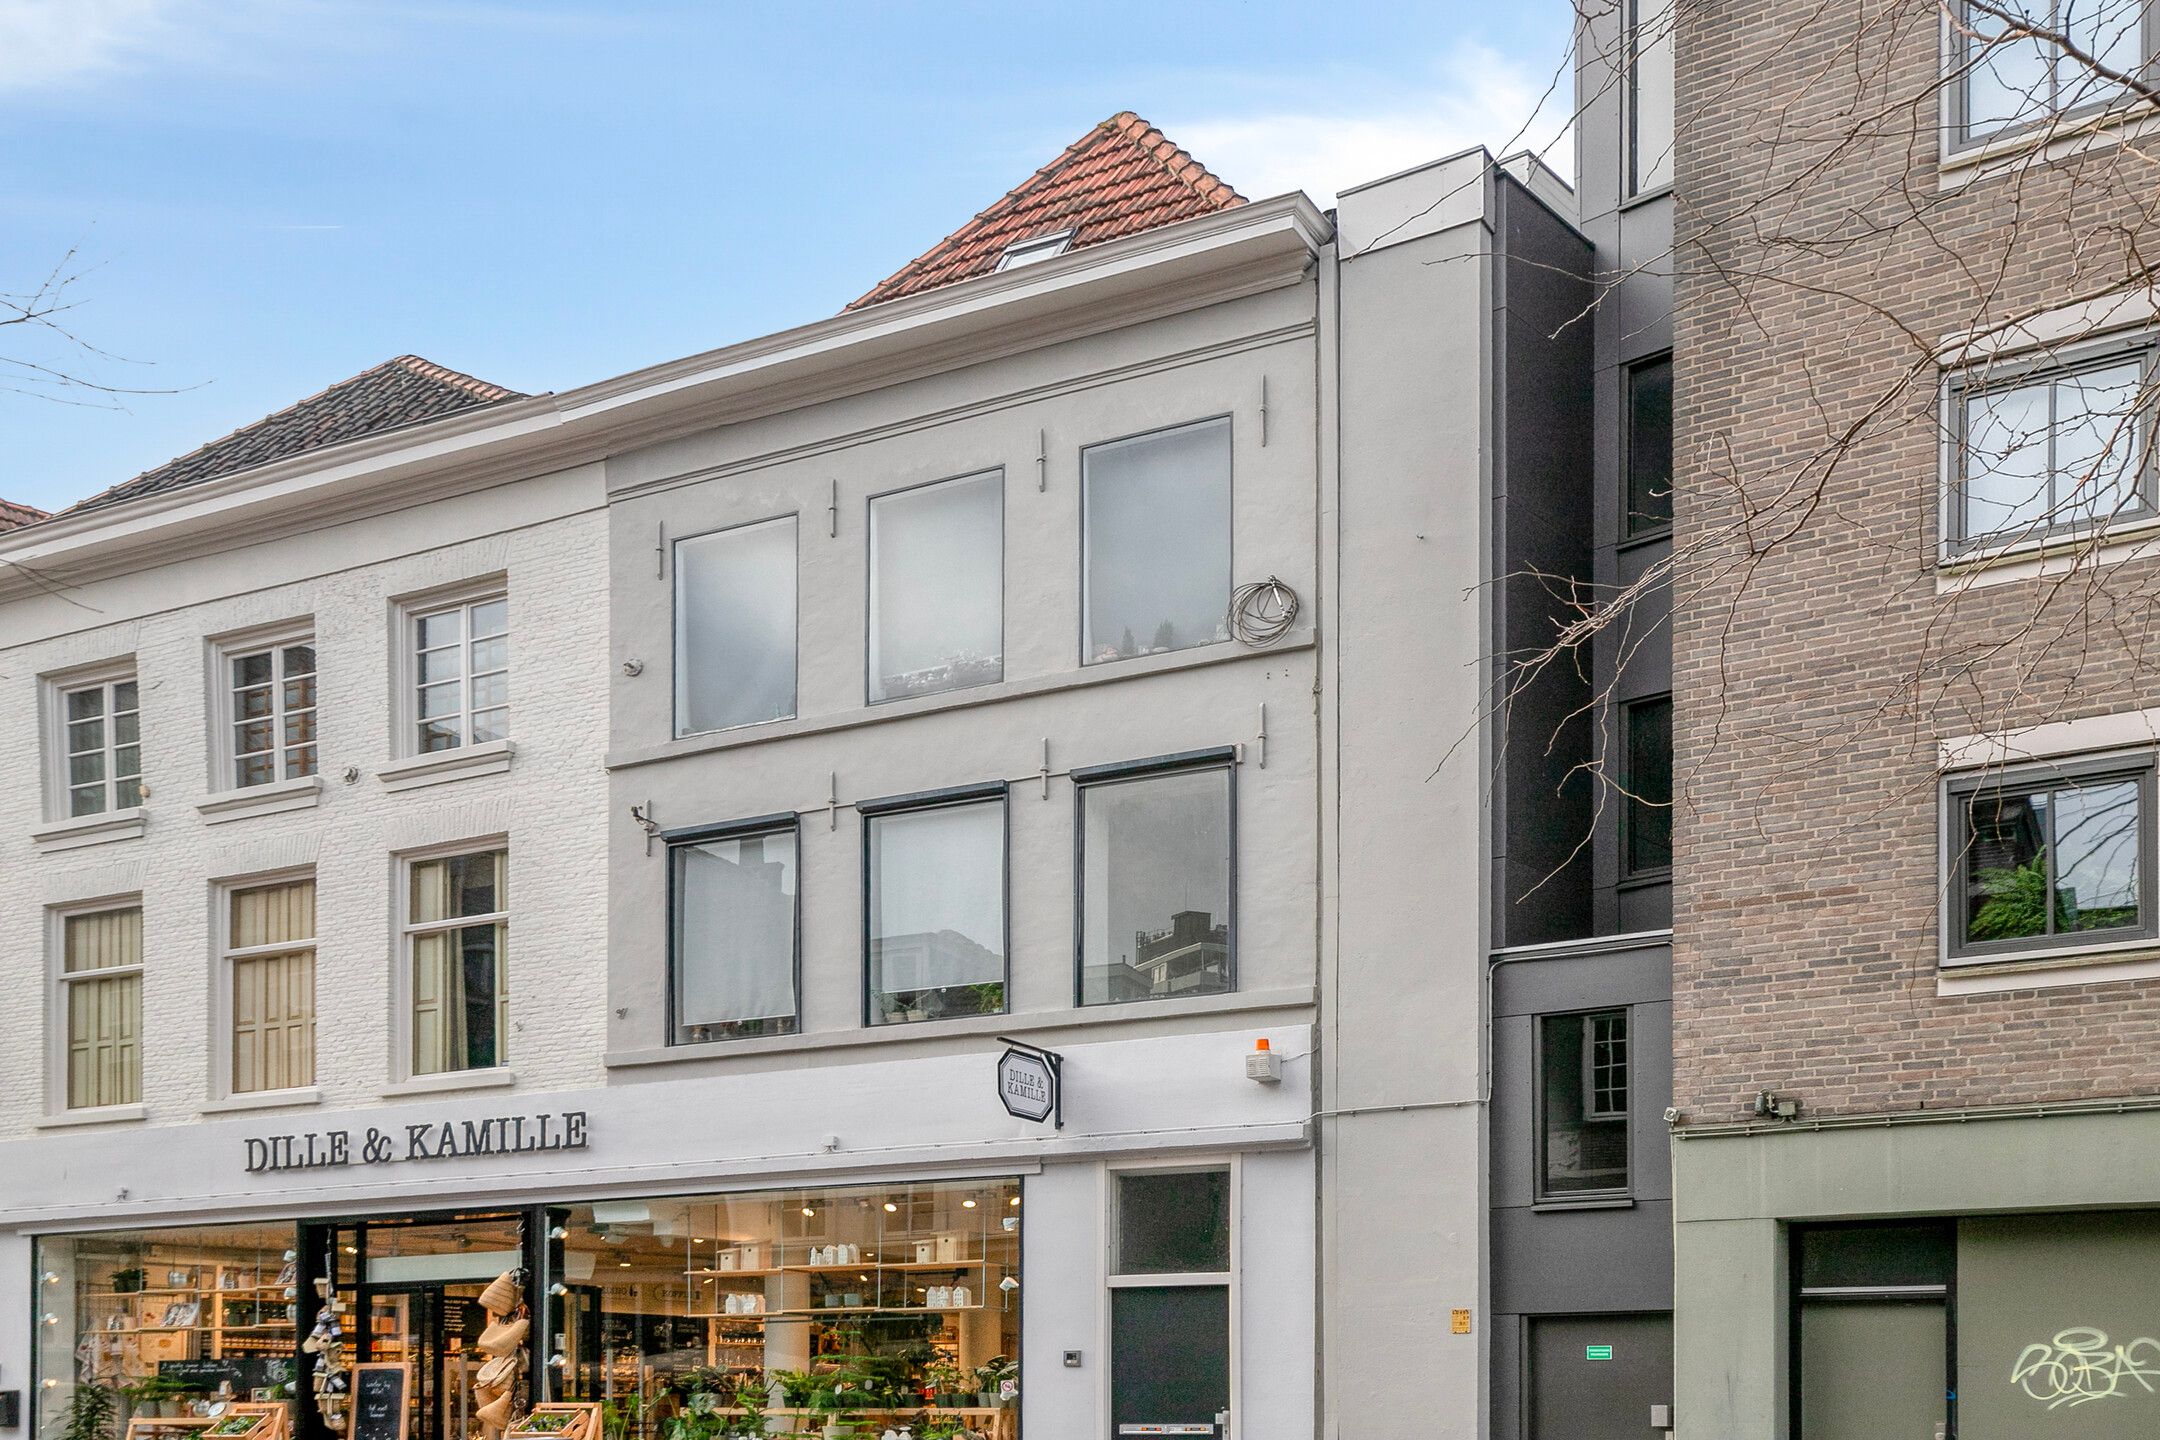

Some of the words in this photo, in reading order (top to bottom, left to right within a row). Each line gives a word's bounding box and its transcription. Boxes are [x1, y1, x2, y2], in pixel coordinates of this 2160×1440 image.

[1010, 1069, 1034, 1087] DILLE
[1036, 1076, 1044, 1090] &
[1008, 1082, 1046, 1103] KAMILLE
[244, 1130, 349, 1172] DILLE
[362, 1127, 392, 1164] &
[405, 1111, 588, 1161] KAMILLE
